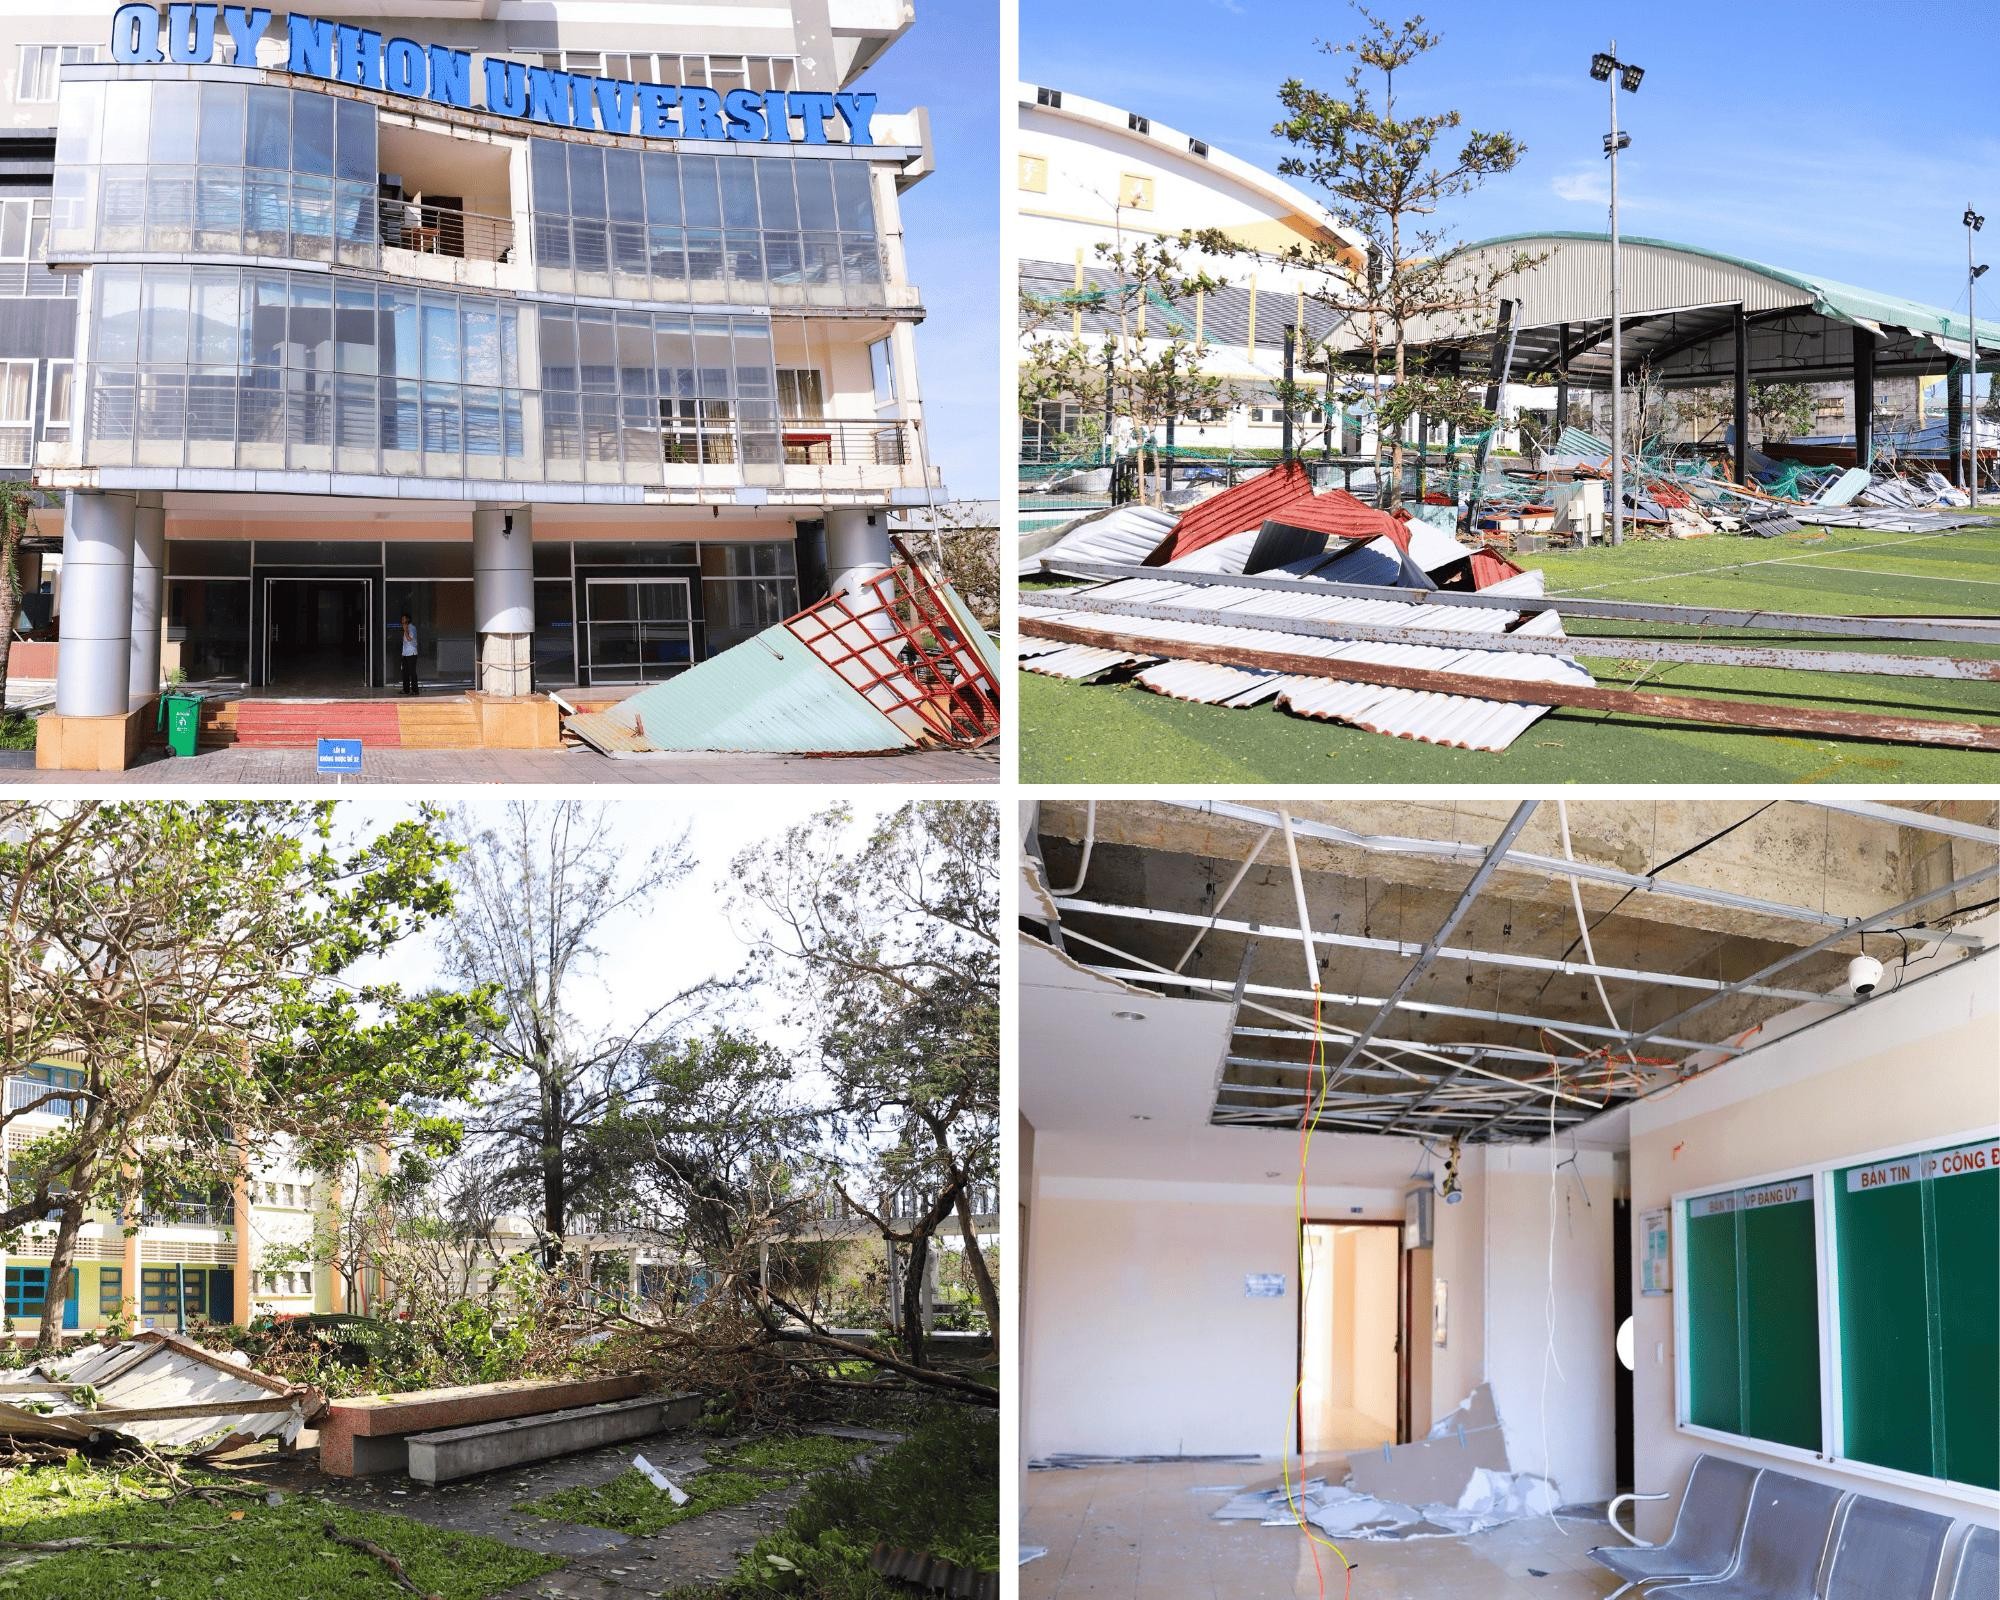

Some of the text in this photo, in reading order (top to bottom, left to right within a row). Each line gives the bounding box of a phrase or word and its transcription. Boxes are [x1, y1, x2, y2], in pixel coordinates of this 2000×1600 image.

[112, 2, 878, 145] QUY NHON UNIVERSITY
[1861, 1165, 1886, 1188] BẢN
[1890, 1165, 1910, 1181] TIN
[1943, 1151, 1985, 1174] CÔNG
